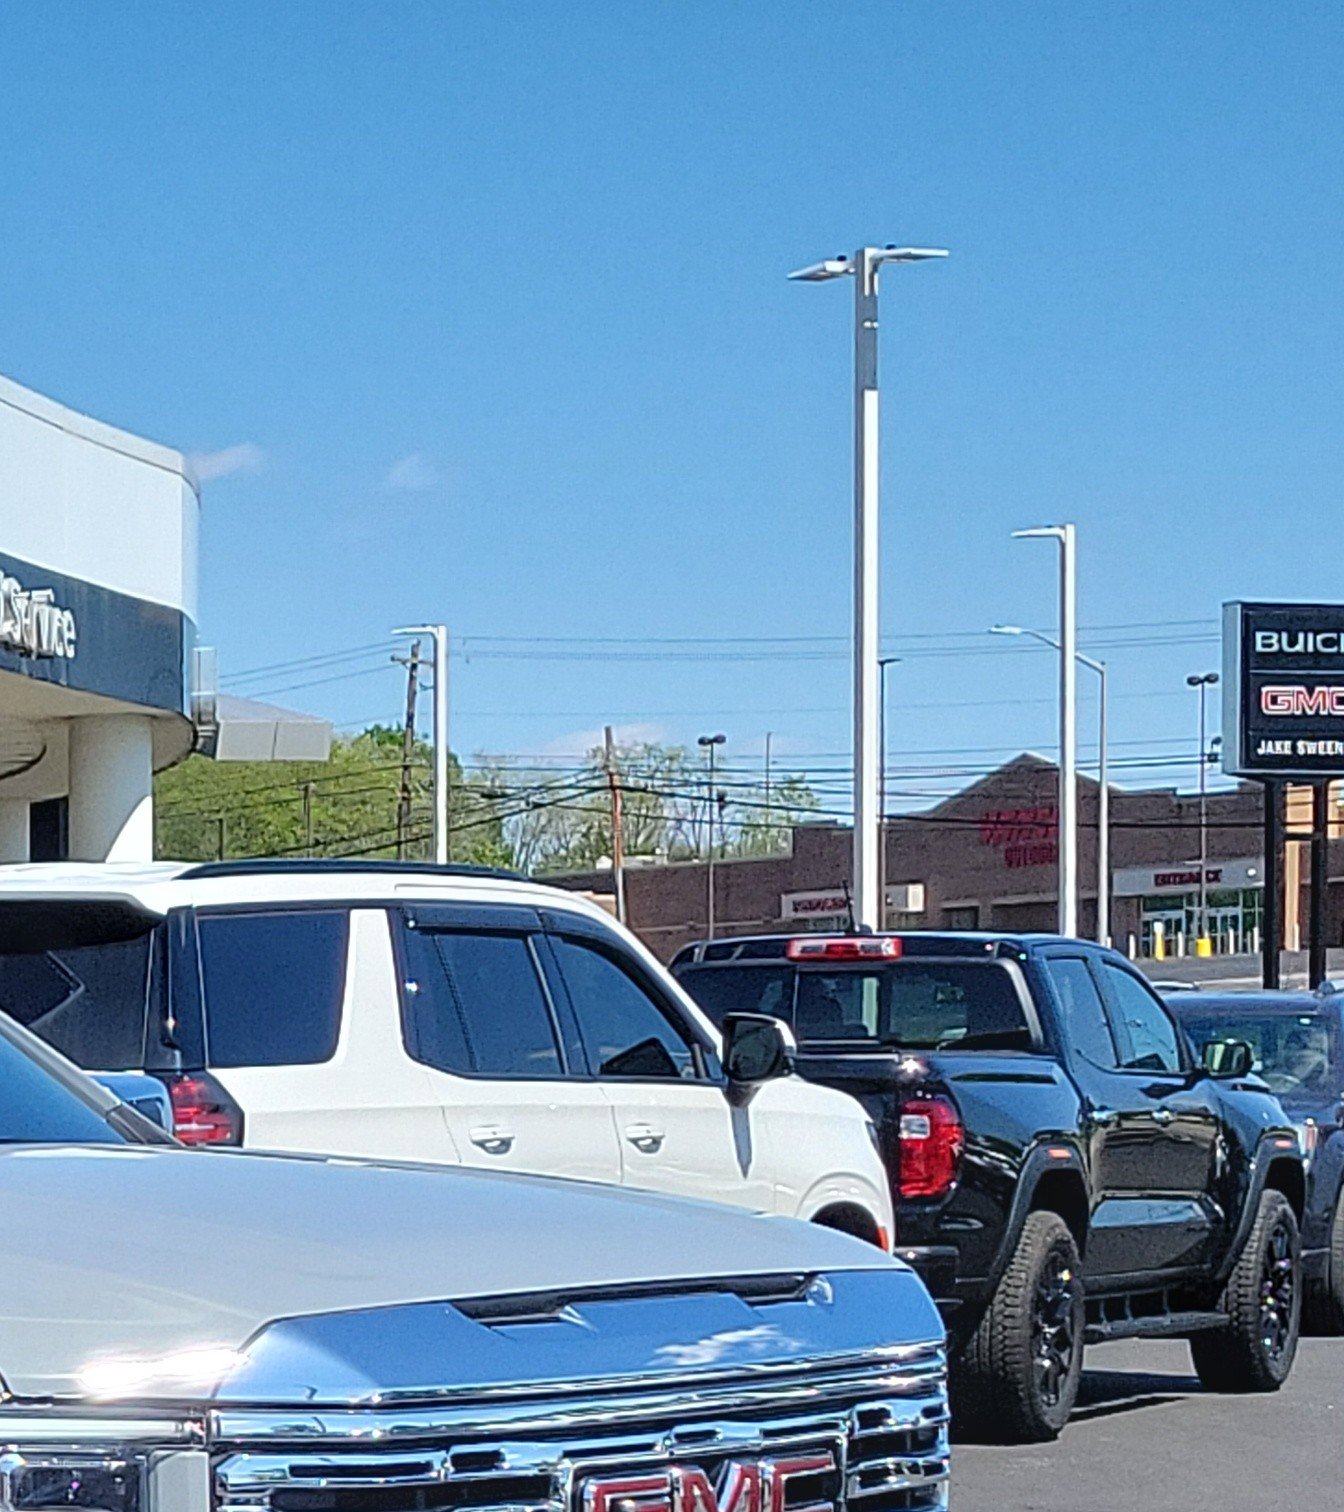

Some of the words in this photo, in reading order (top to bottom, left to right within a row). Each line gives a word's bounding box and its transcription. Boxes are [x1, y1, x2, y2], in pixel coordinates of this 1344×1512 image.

[3, 577, 77, 660] Service
[1255, 631, 1344, 653] BUIC
[1257, 740, 1293, 755] JAKE
